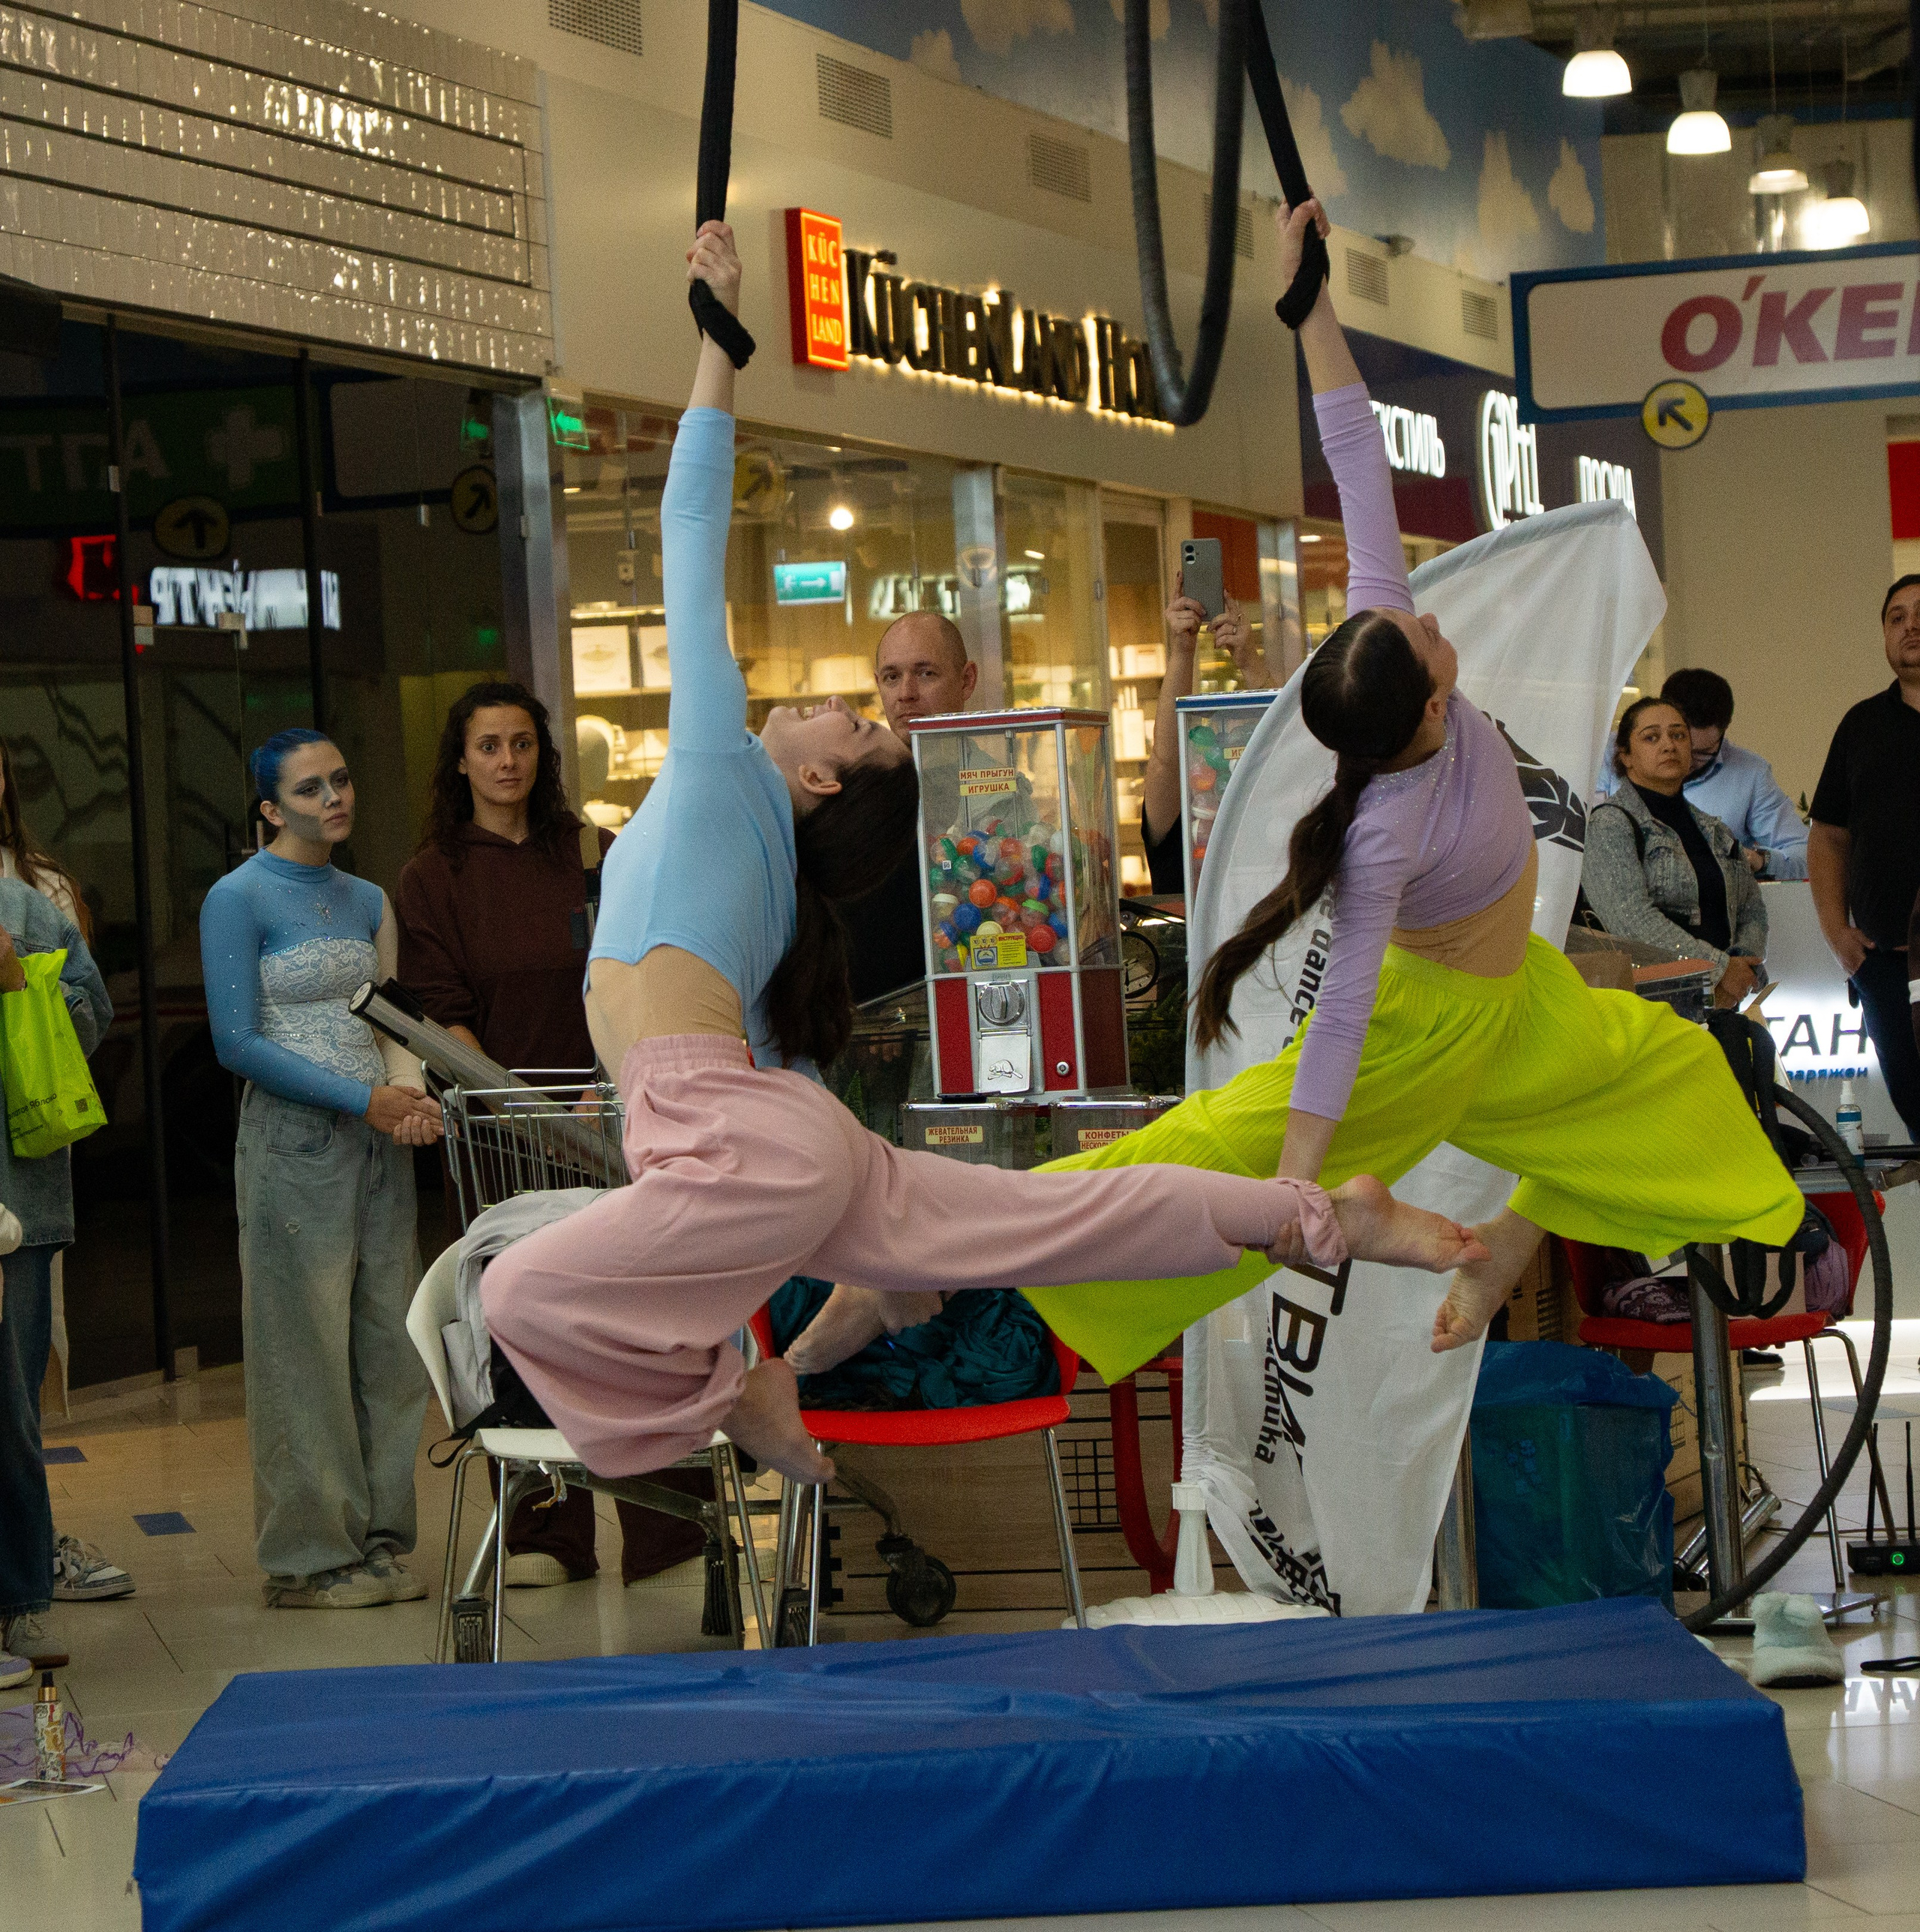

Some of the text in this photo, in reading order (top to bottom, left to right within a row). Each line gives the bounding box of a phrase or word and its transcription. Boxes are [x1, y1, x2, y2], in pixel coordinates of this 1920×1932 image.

[808, 232, 838, 268] KÜC
[810, 273, 840, 304] HEN
[812, 314, 842, 346] LAND
[1096, 316, 1170, 422] HO
[1369, 400, 1445, 478] КСТИЛЬ
[960, 769, 1014, 779] МЯЧ ПРЫГУН
[968, 782, 1010, 794] ИГРУШКА
[8, 1104, 28, 1120] олотое
[928, 1126, 977, 1136] ЖЕВАТЕЛЬНАЯ
